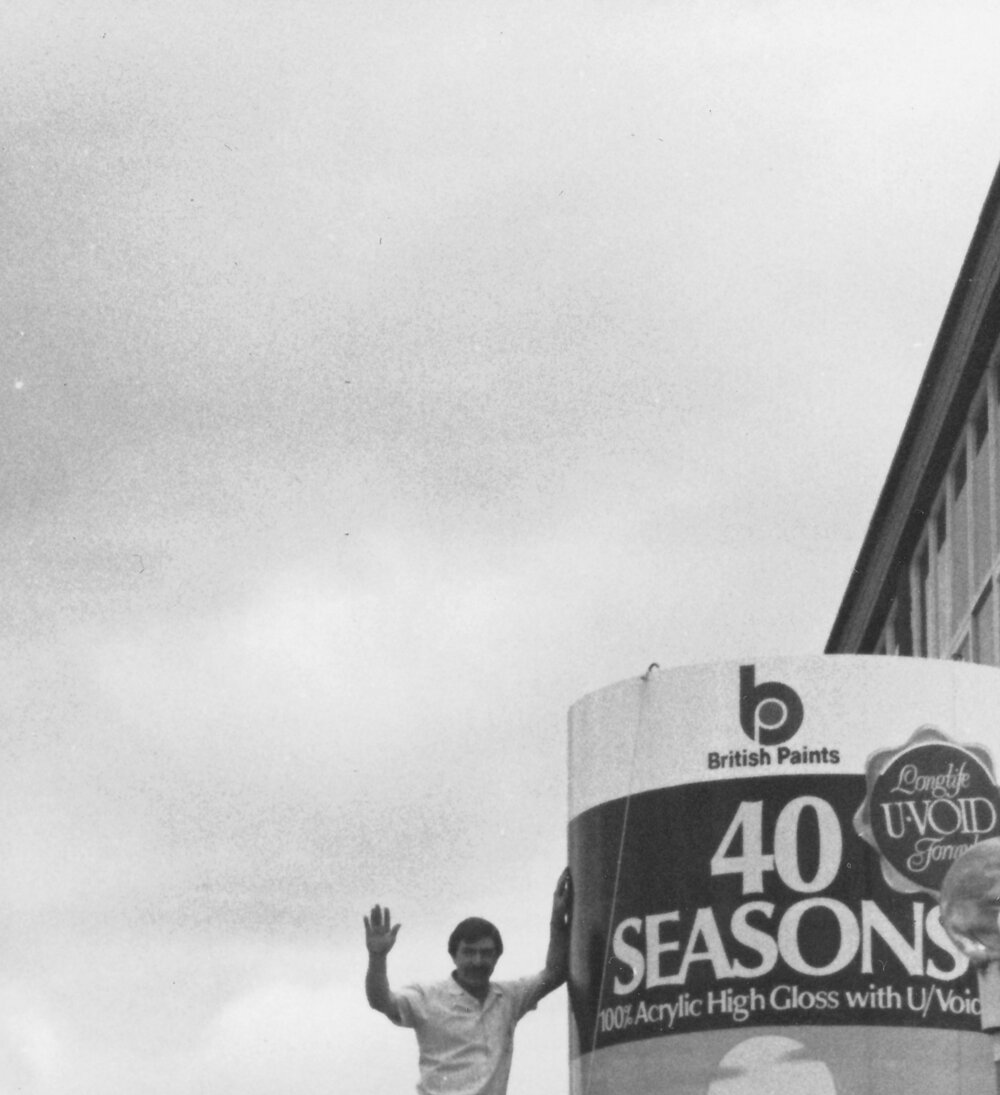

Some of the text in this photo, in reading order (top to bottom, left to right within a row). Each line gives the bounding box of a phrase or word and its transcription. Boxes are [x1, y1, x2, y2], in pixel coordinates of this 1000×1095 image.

[708, 745, 840, 770] British Paints
[890, 761, 970, 799] Longlife
[710, 796, 843, 895] 40
[906, 835, 980, 873] Form
[613, 898, 971, 996] SEASONS
[600, 1005, 632, 1033] 100%
[635, 993, 703, 1028] Acrylic
[707, 987, 765, 1022] High
[770, 985, 839, 1010] Gloss
[846, 983, 901, 1009] with
